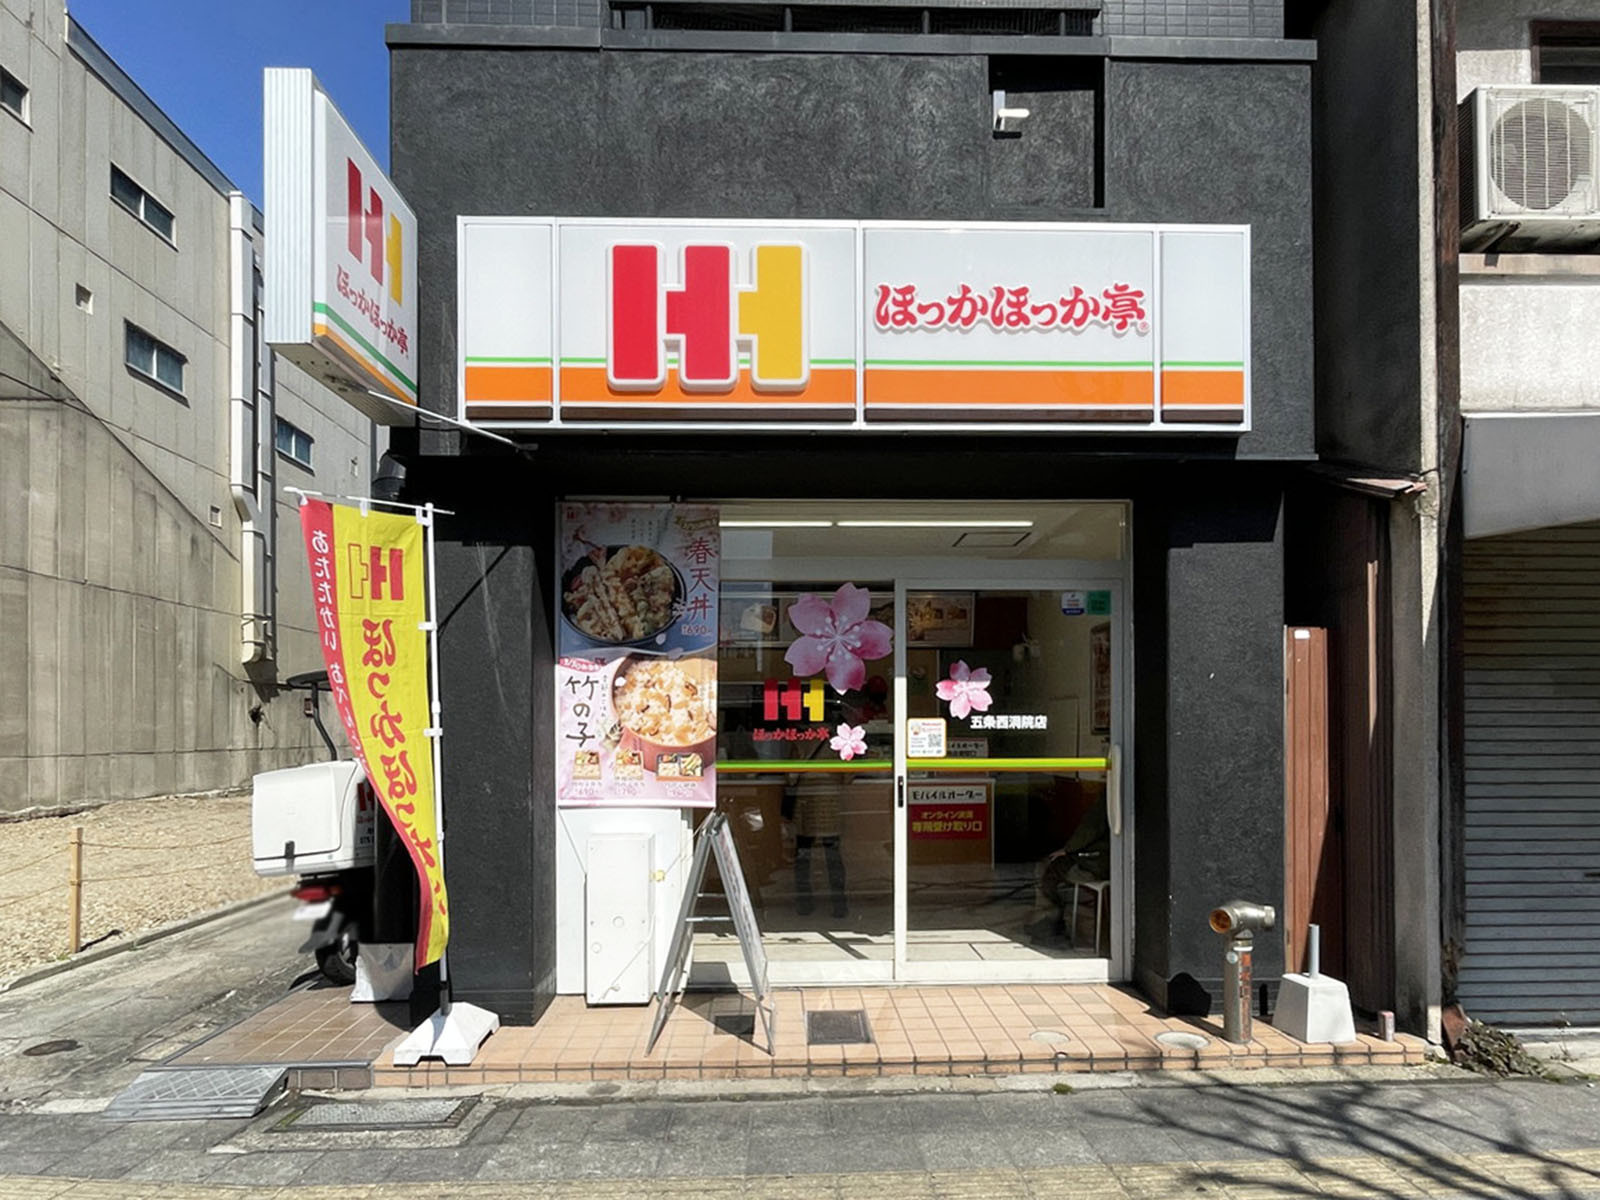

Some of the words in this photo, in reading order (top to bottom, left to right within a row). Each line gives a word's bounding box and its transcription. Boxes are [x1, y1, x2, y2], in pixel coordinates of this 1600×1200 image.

[336, 264, 408, 355] ほっかほっか亭
[875, 283, 1147, 331] ほっかほっか亭
[564, 675, 600, 748] 竹の子
[912, 790, 983, 800] モバイルオーダー
